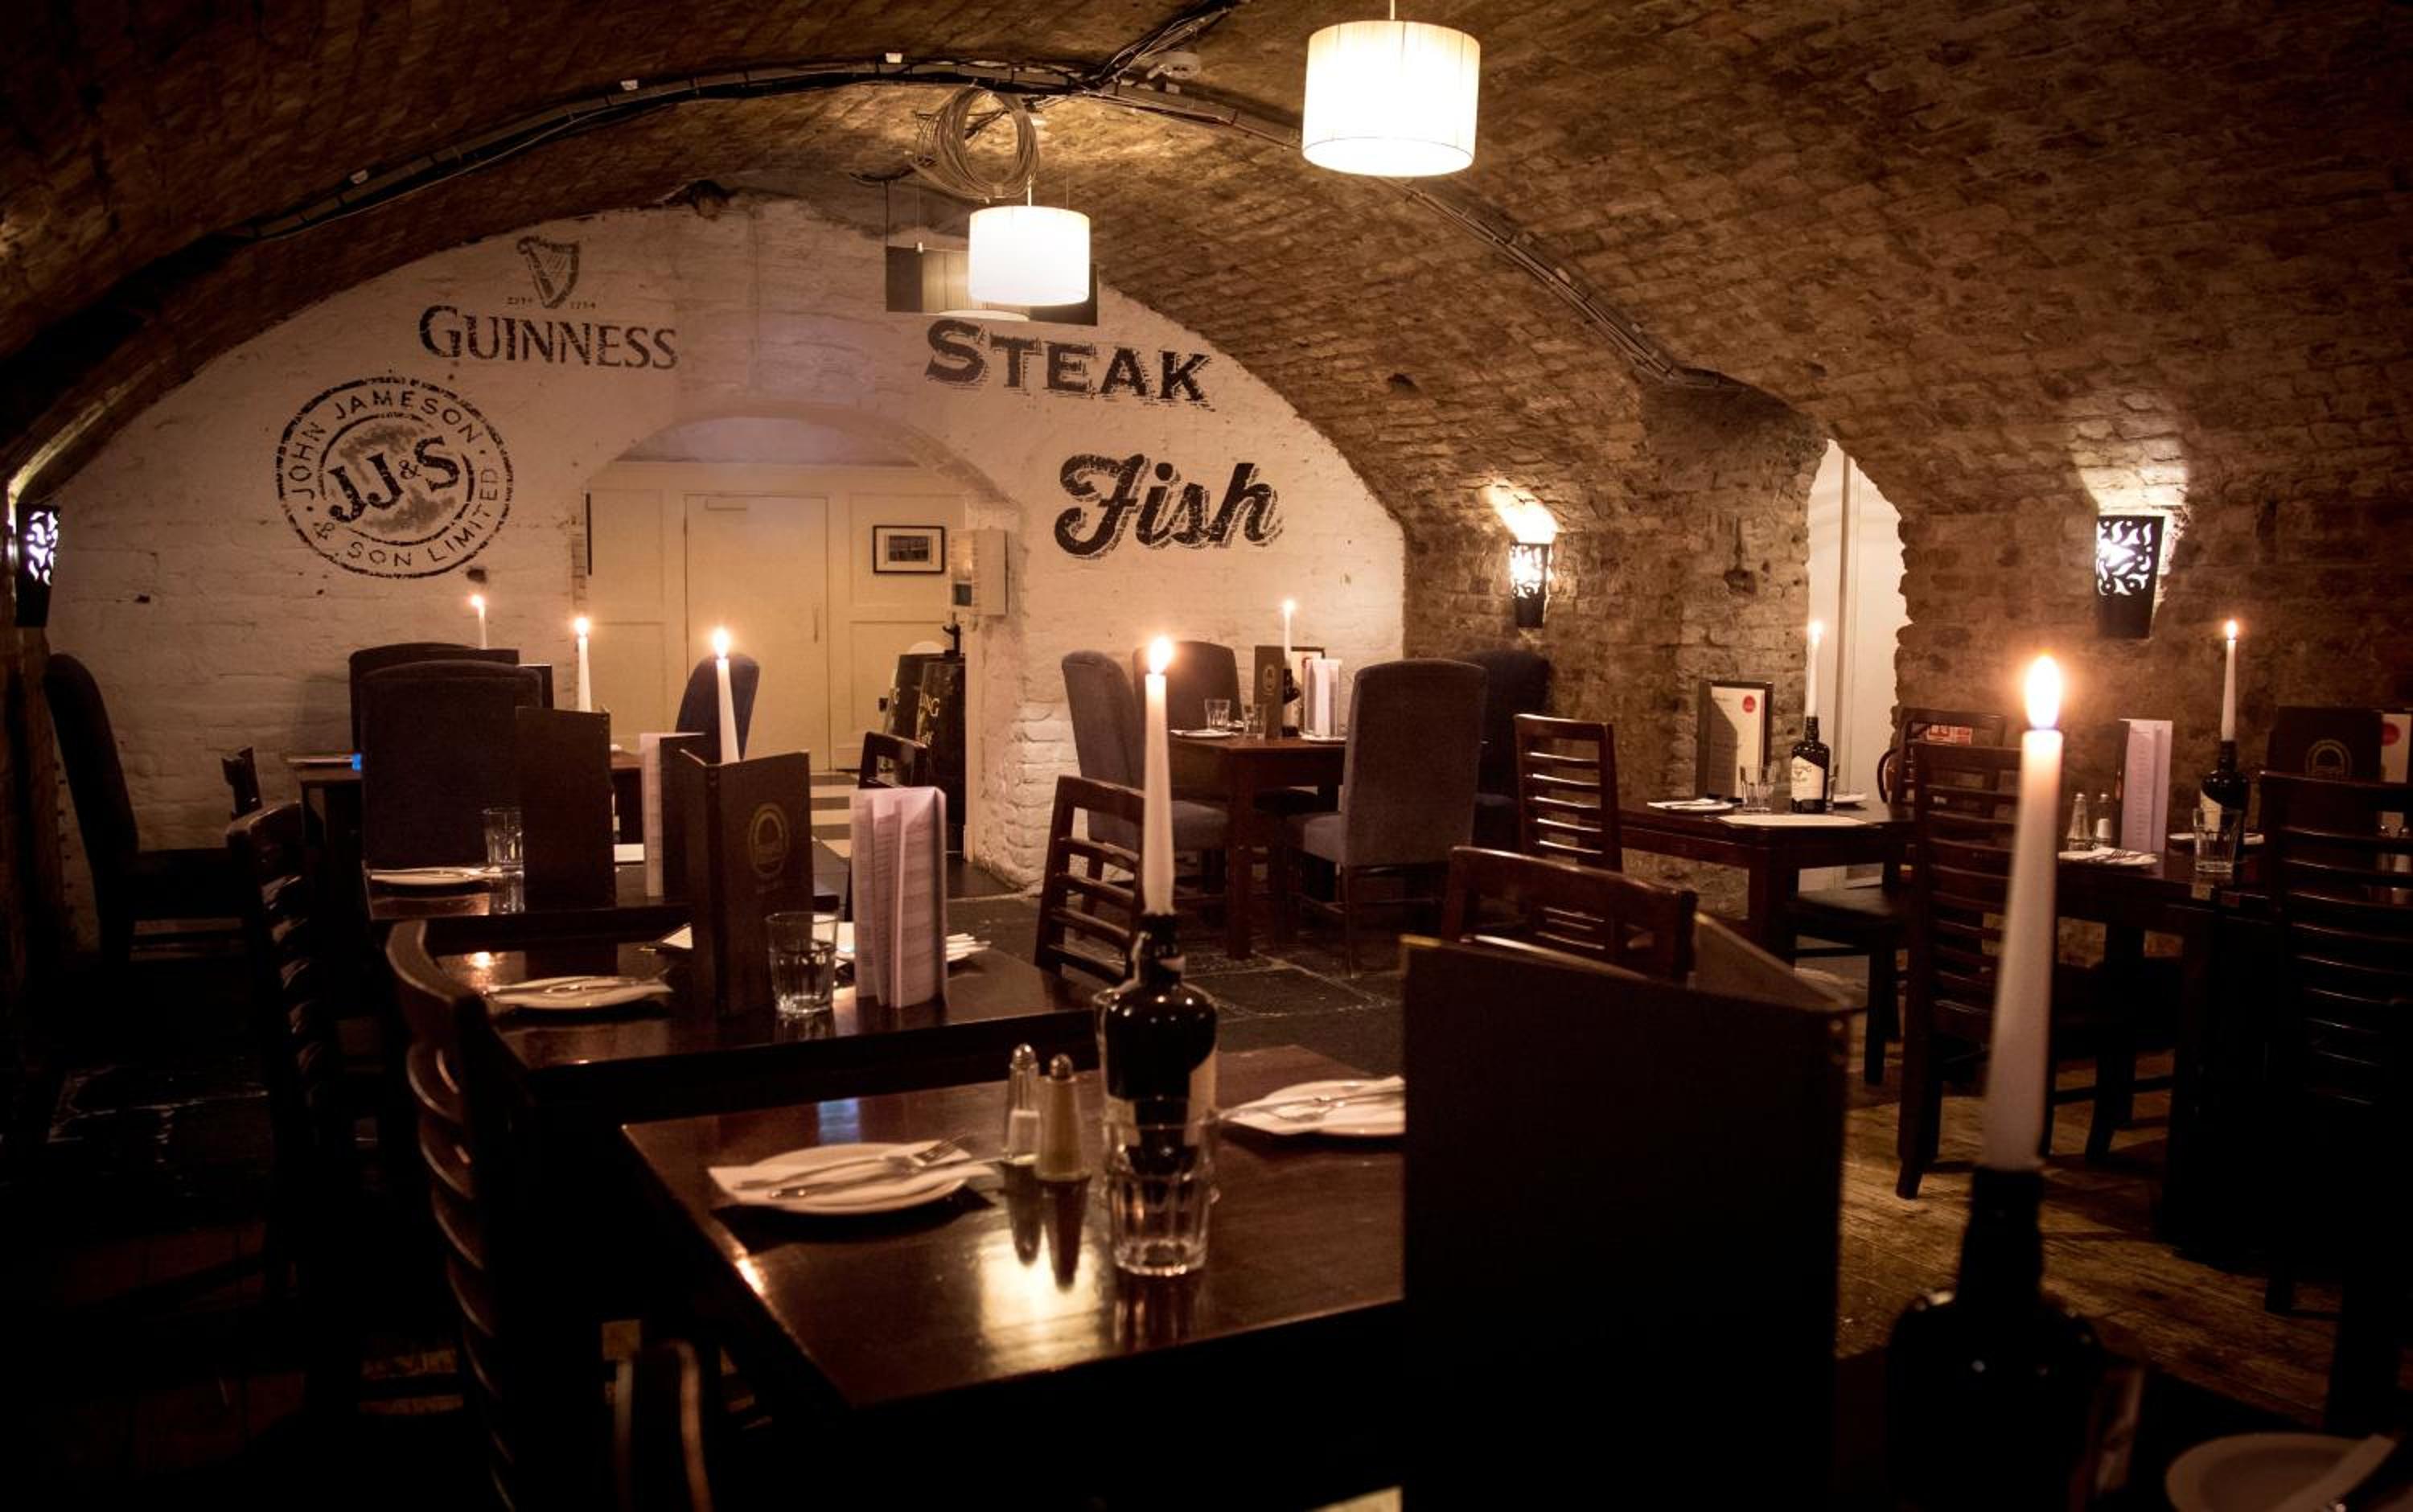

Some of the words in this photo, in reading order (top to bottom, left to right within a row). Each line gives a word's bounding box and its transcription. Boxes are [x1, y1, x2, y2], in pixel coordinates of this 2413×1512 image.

[419, 305, 679, 370] GUINNESS
[925, 318, 1213, 407] STEAK
[288, 422, 326, 499] JOHN
[335, 390, 483, 443] JAMESON
[314, 523, 335, 540] &
[347, 541, 411, 567] SON
[427, 468, 499, 562] LIMITED
[1054, 453, 1283, 560] Fish
